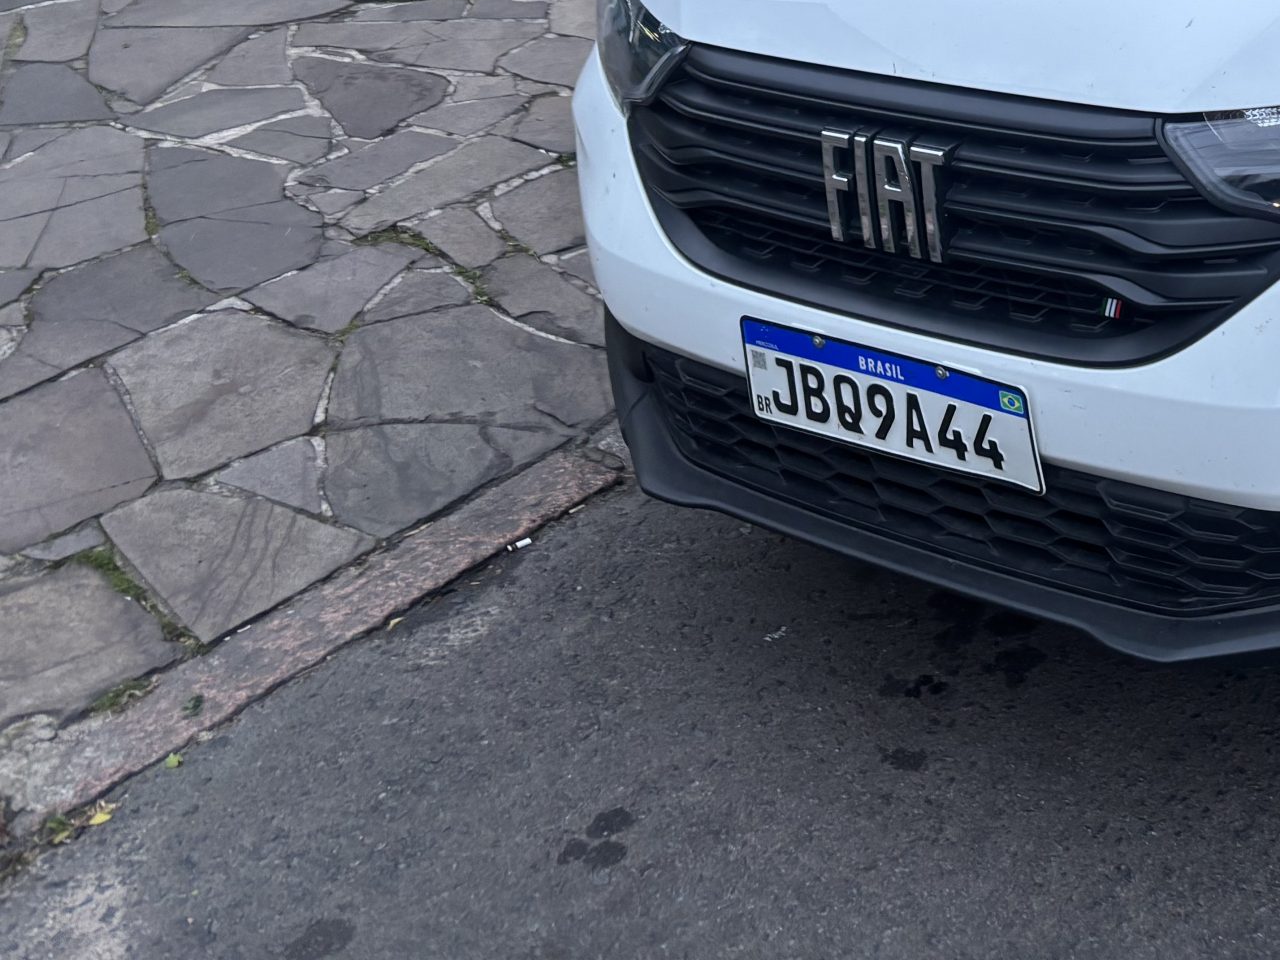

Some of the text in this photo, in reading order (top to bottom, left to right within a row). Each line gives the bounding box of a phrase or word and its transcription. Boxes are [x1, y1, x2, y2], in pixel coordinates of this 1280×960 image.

[821, 130, 945, 263] FIAT
[858, 355, 905, 381] BRASIL
[757, 394, 773, 415] BR
[772, 356, 1005, 471] JBQ9A44
